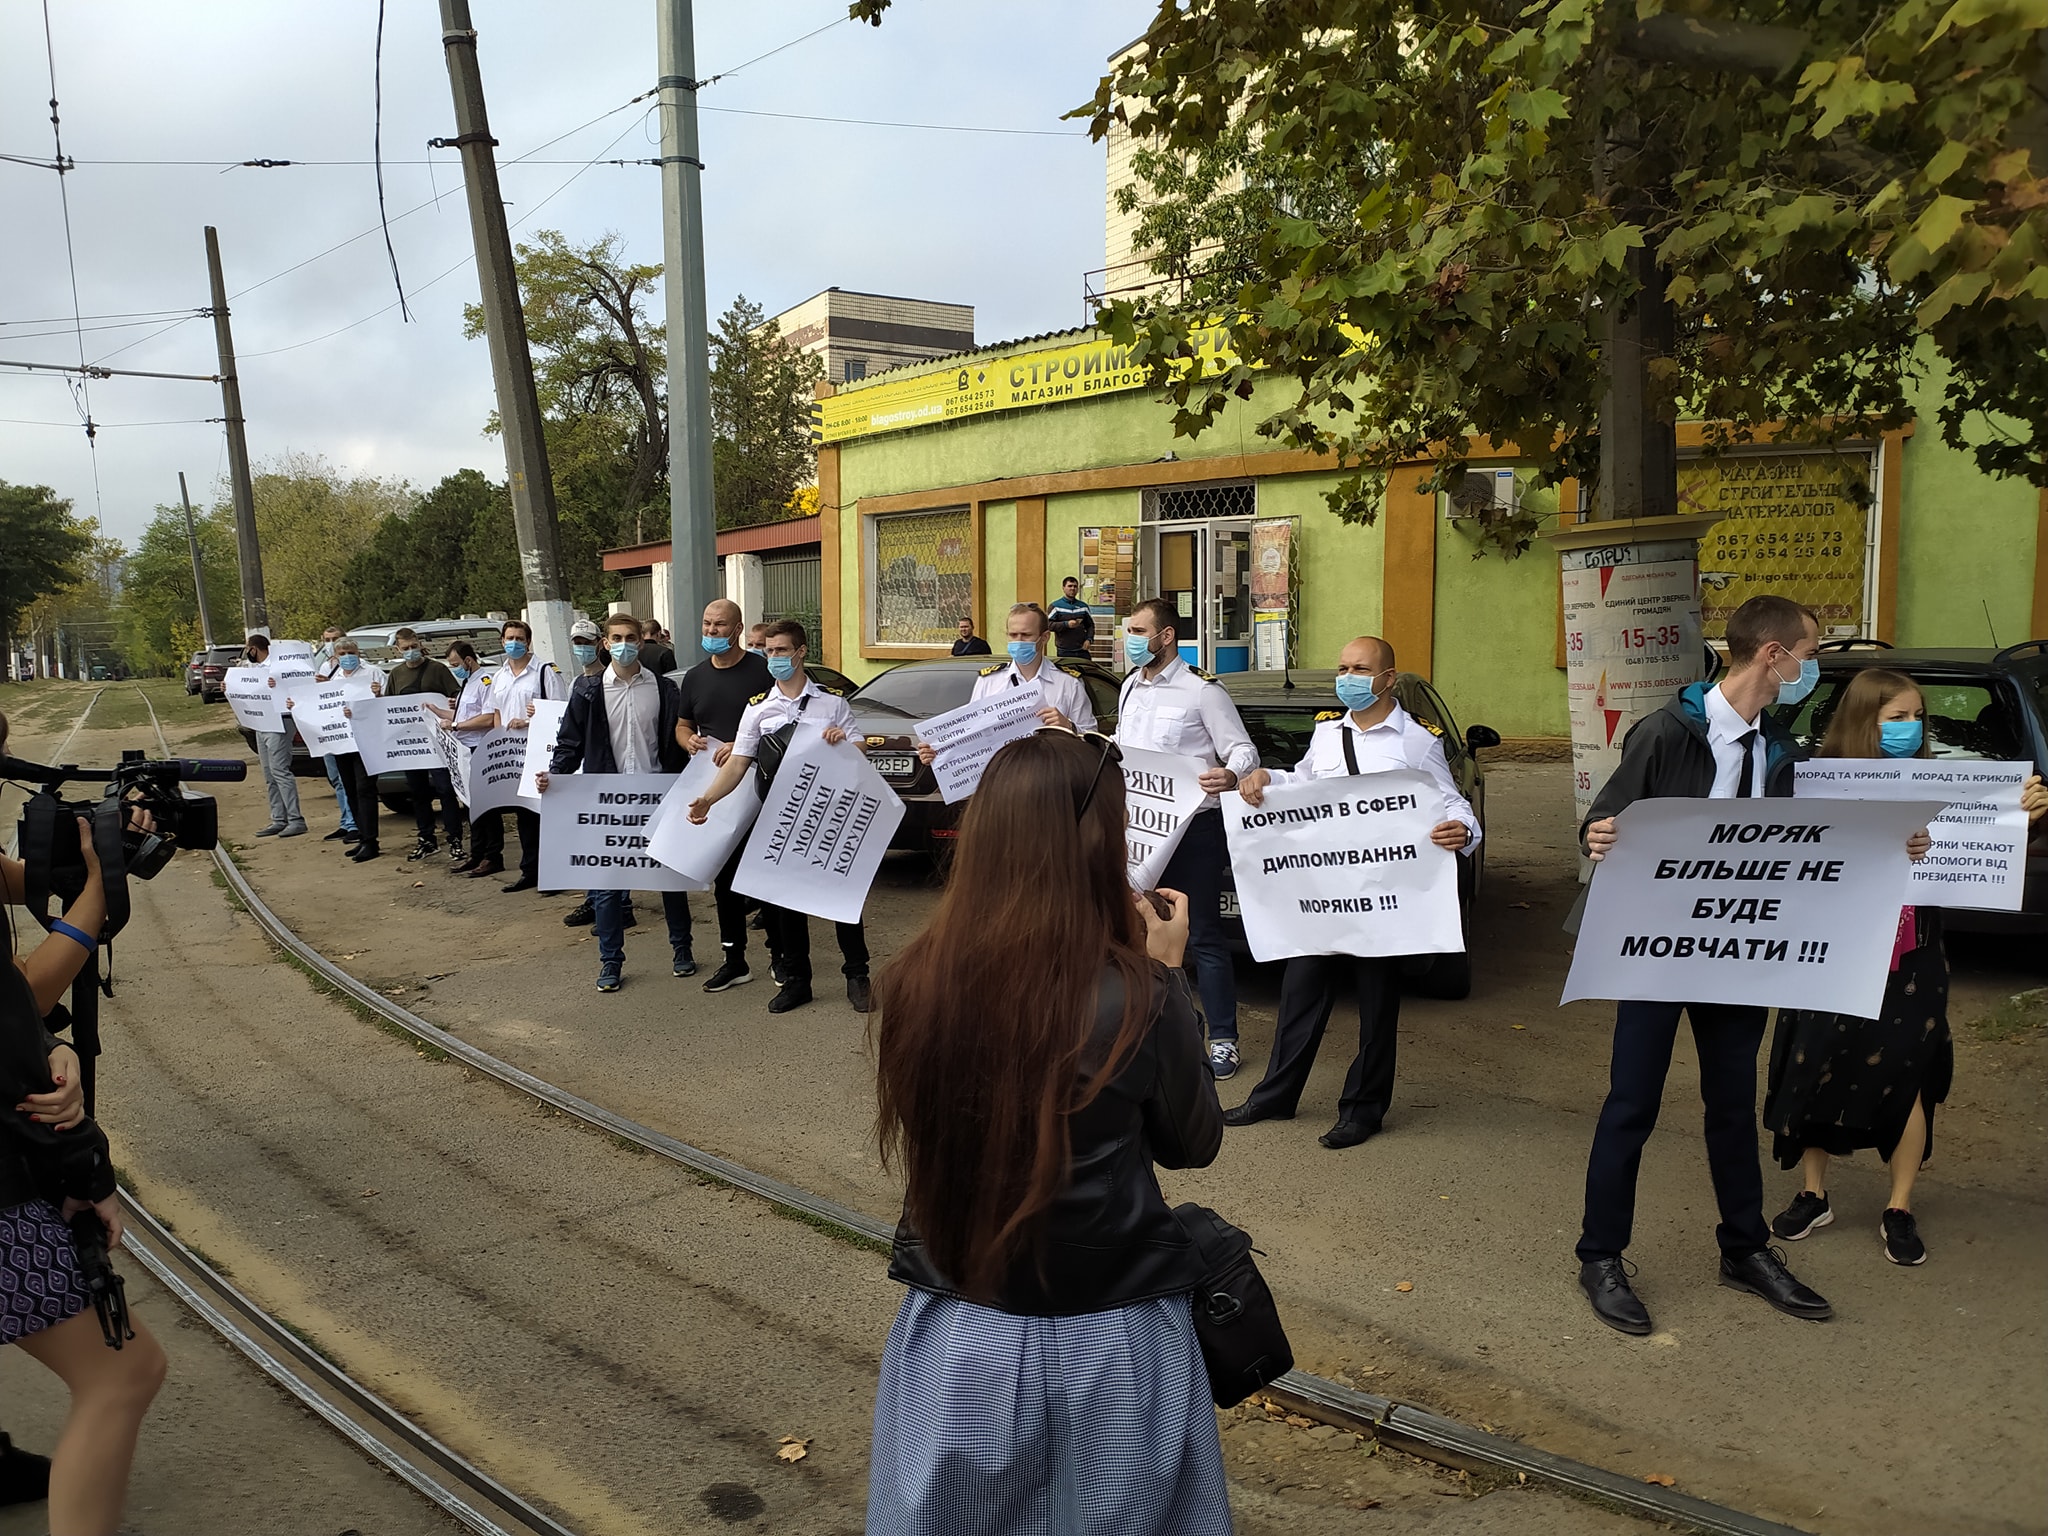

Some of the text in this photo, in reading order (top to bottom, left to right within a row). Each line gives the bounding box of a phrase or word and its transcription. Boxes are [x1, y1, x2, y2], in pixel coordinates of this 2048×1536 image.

[1011, 382, 1073, 403] МАГАЗИН
[1083, 362, 1181, 393] БЛАГОСТЙ
[945, 389, 995, 406] 067 654 25 73
[870, 404, 943, 427] blagostroy.od.ua
[945, 400, 995, 417] 067 654 25 48
[1719, 465, 1804, 481] МАГАЗИН
[1716, 531, 1844, 546] 067 654 25 73
[1716, 546, 1844, 561] 067 654 25 48
[1744, 571, 1855, 584] blagostroy.od.ua
[1605, 597, 1637, 609] ЄДИНИЙ
[1637, 596, 1661, 606] ЦЕНТР
[1632, 606, 1672, 616] ГРОМАДЯН
[1621, 625, 1680, 649] 15-35
[1625, 655, 1680, 666] (048) 705-55-55
[982, 689, 1039, 715] УСІ ТРЕНАЖЕРНІ
[386, 716, 425, 725] ХАБАРА
[997, 706, 1026, 721] ЦЕНТРИ
[921, 711, 979, 738] УСІ ТРЕНАЖЕРНІ
[993, 720, 1015, 733] РІВНИ
[317, 733, 349, 744] ДИПЛОМА
[937, 727, 966, 743] ЦЕНТРИ
[486, 737, 527, 750] МОРЯКИ
[386, 748, 432, 759] ДИПЛОМА
[937, 746, 993, 773] УСІ ТРЕНАЖЕРНІ
[188, 761, 201, 774] 7
[893, 759, 910, 771] EP
[951, 762, 980, 778] ЦЕНТРИ
[1122, 767, 1175, 798] РЯКИ
[1795, 770, 1901, 781] МОРАД ТА КРИКЛІЙ
[1912, 772, 2023, 784] МОРАД ТА КРИКЛІЙ
[949, 777, 970, 791] РІВНИ
[598, 792, 663, 805] МОРЯК
[1949, 801, 1999, 812] УПЦІЙНА
[577, 813, 650, 826] БІЛЬШЕ
[763, 762, 817, 864] УКРАЇНСЬКІ
[1128, 804, 1180, 834] ЛОНІ
[1241, 794, 1418, 830] КОРУПЦІЯ В СФЕРІ
[791, 785, 834, 857] МОРЯКИ
[811, 788, 856, 868] У ПОЛОНІ
[833, 793, 879, 876] КОРУПЦІЇ
[1707, 823, 1831, 845] МОРЯК
[605, 835, 651, 850] БУДЕ
[1929, 840, 2015, 854] РЯКИ ЧЕКАЮТ
[571, 854, 662, 869] МОВЧАТИ
[1262, 844, 1418, 875] ДИПЛОМУВАННЯ
[1912, 855, 2008, 871] ДОПОМОГИ ВІД
[1653, 859, 1845, 883] БІЛЬШЕ НЕ
[1913, 871, 2006, 885] ПРЕЗИДЕНТА !!!
[1298, 894, 1399, 914] МОРЯКІВ !!!
[1691, 897, 1782, 925] БУДЕ
[1620, 935, 1830, 964] МОВЧАТИ !!!
